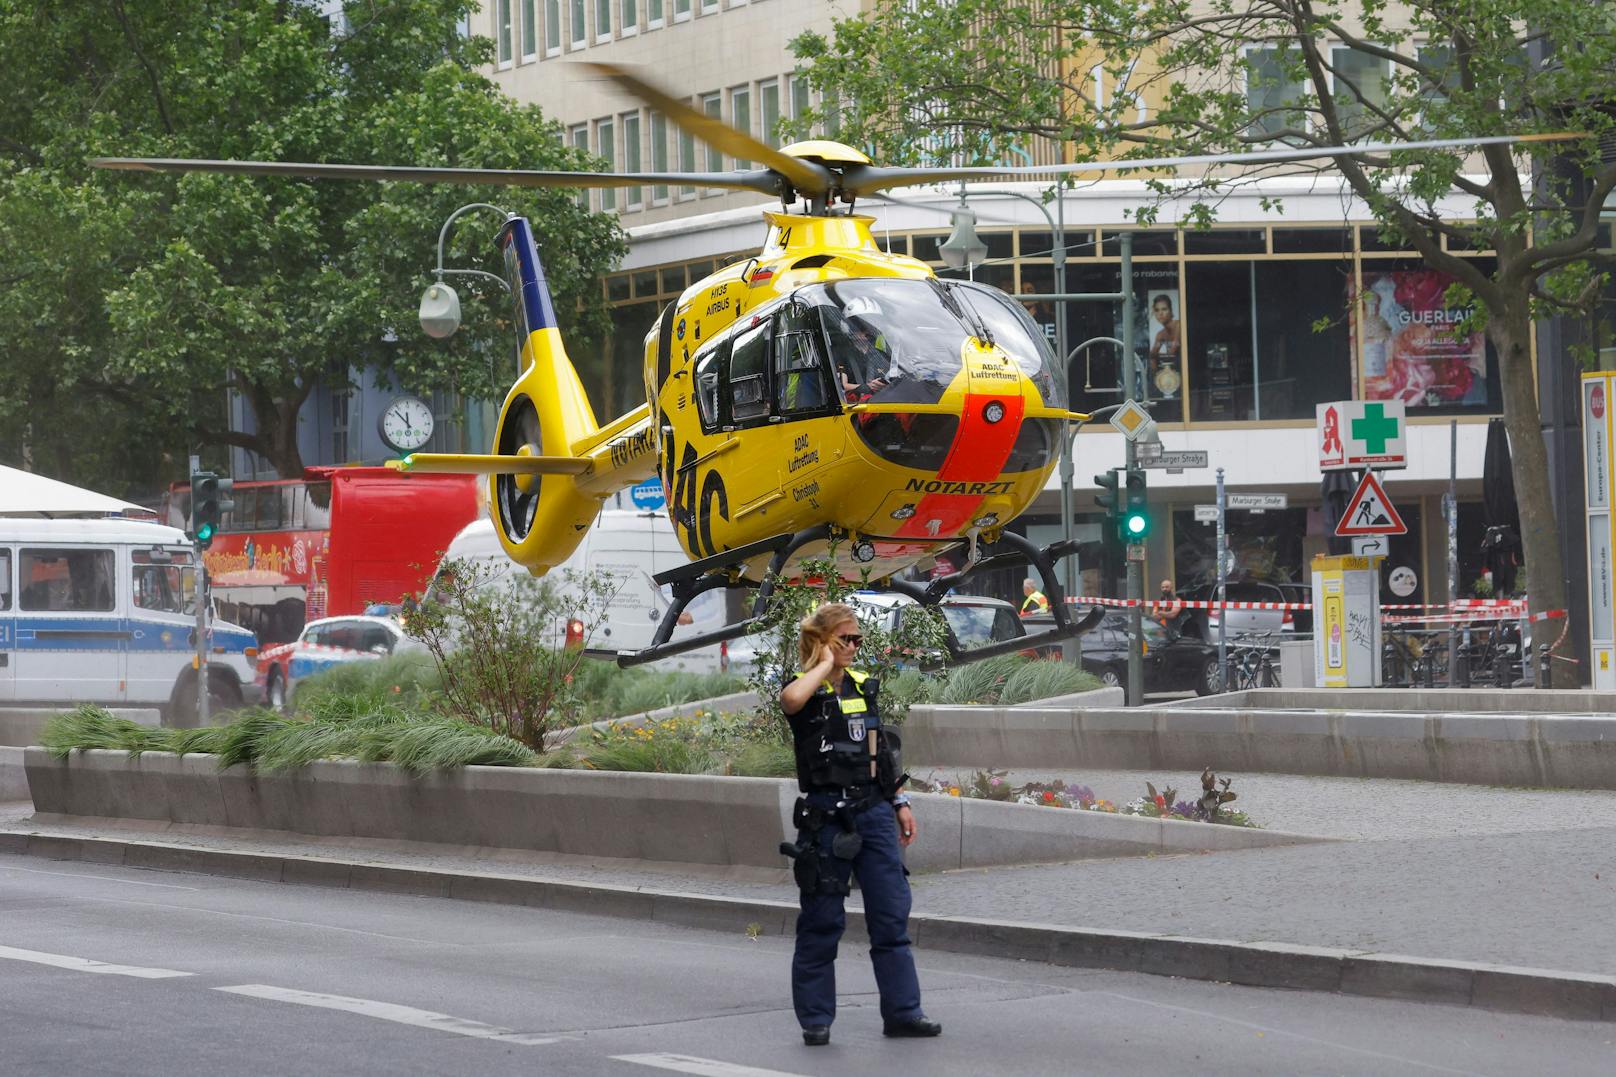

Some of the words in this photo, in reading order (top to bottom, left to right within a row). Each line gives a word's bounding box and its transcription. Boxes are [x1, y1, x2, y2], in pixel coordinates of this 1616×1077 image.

[711, 284, 728, 299] H135
[706, 298, 730, 317] AIRBUS
[971, 371, 1018, 382] Luftrettung
[1592, 396, 1605, 408] BUS
[611, 426, 656, 470] NOTARZ
[794, 433, 809, 453] ADAC
[788, 449, 819, 473] Luftrettung
[793, 479, 820, 502] Christoph
[905, 478, 1015, 494] NOTARZT
